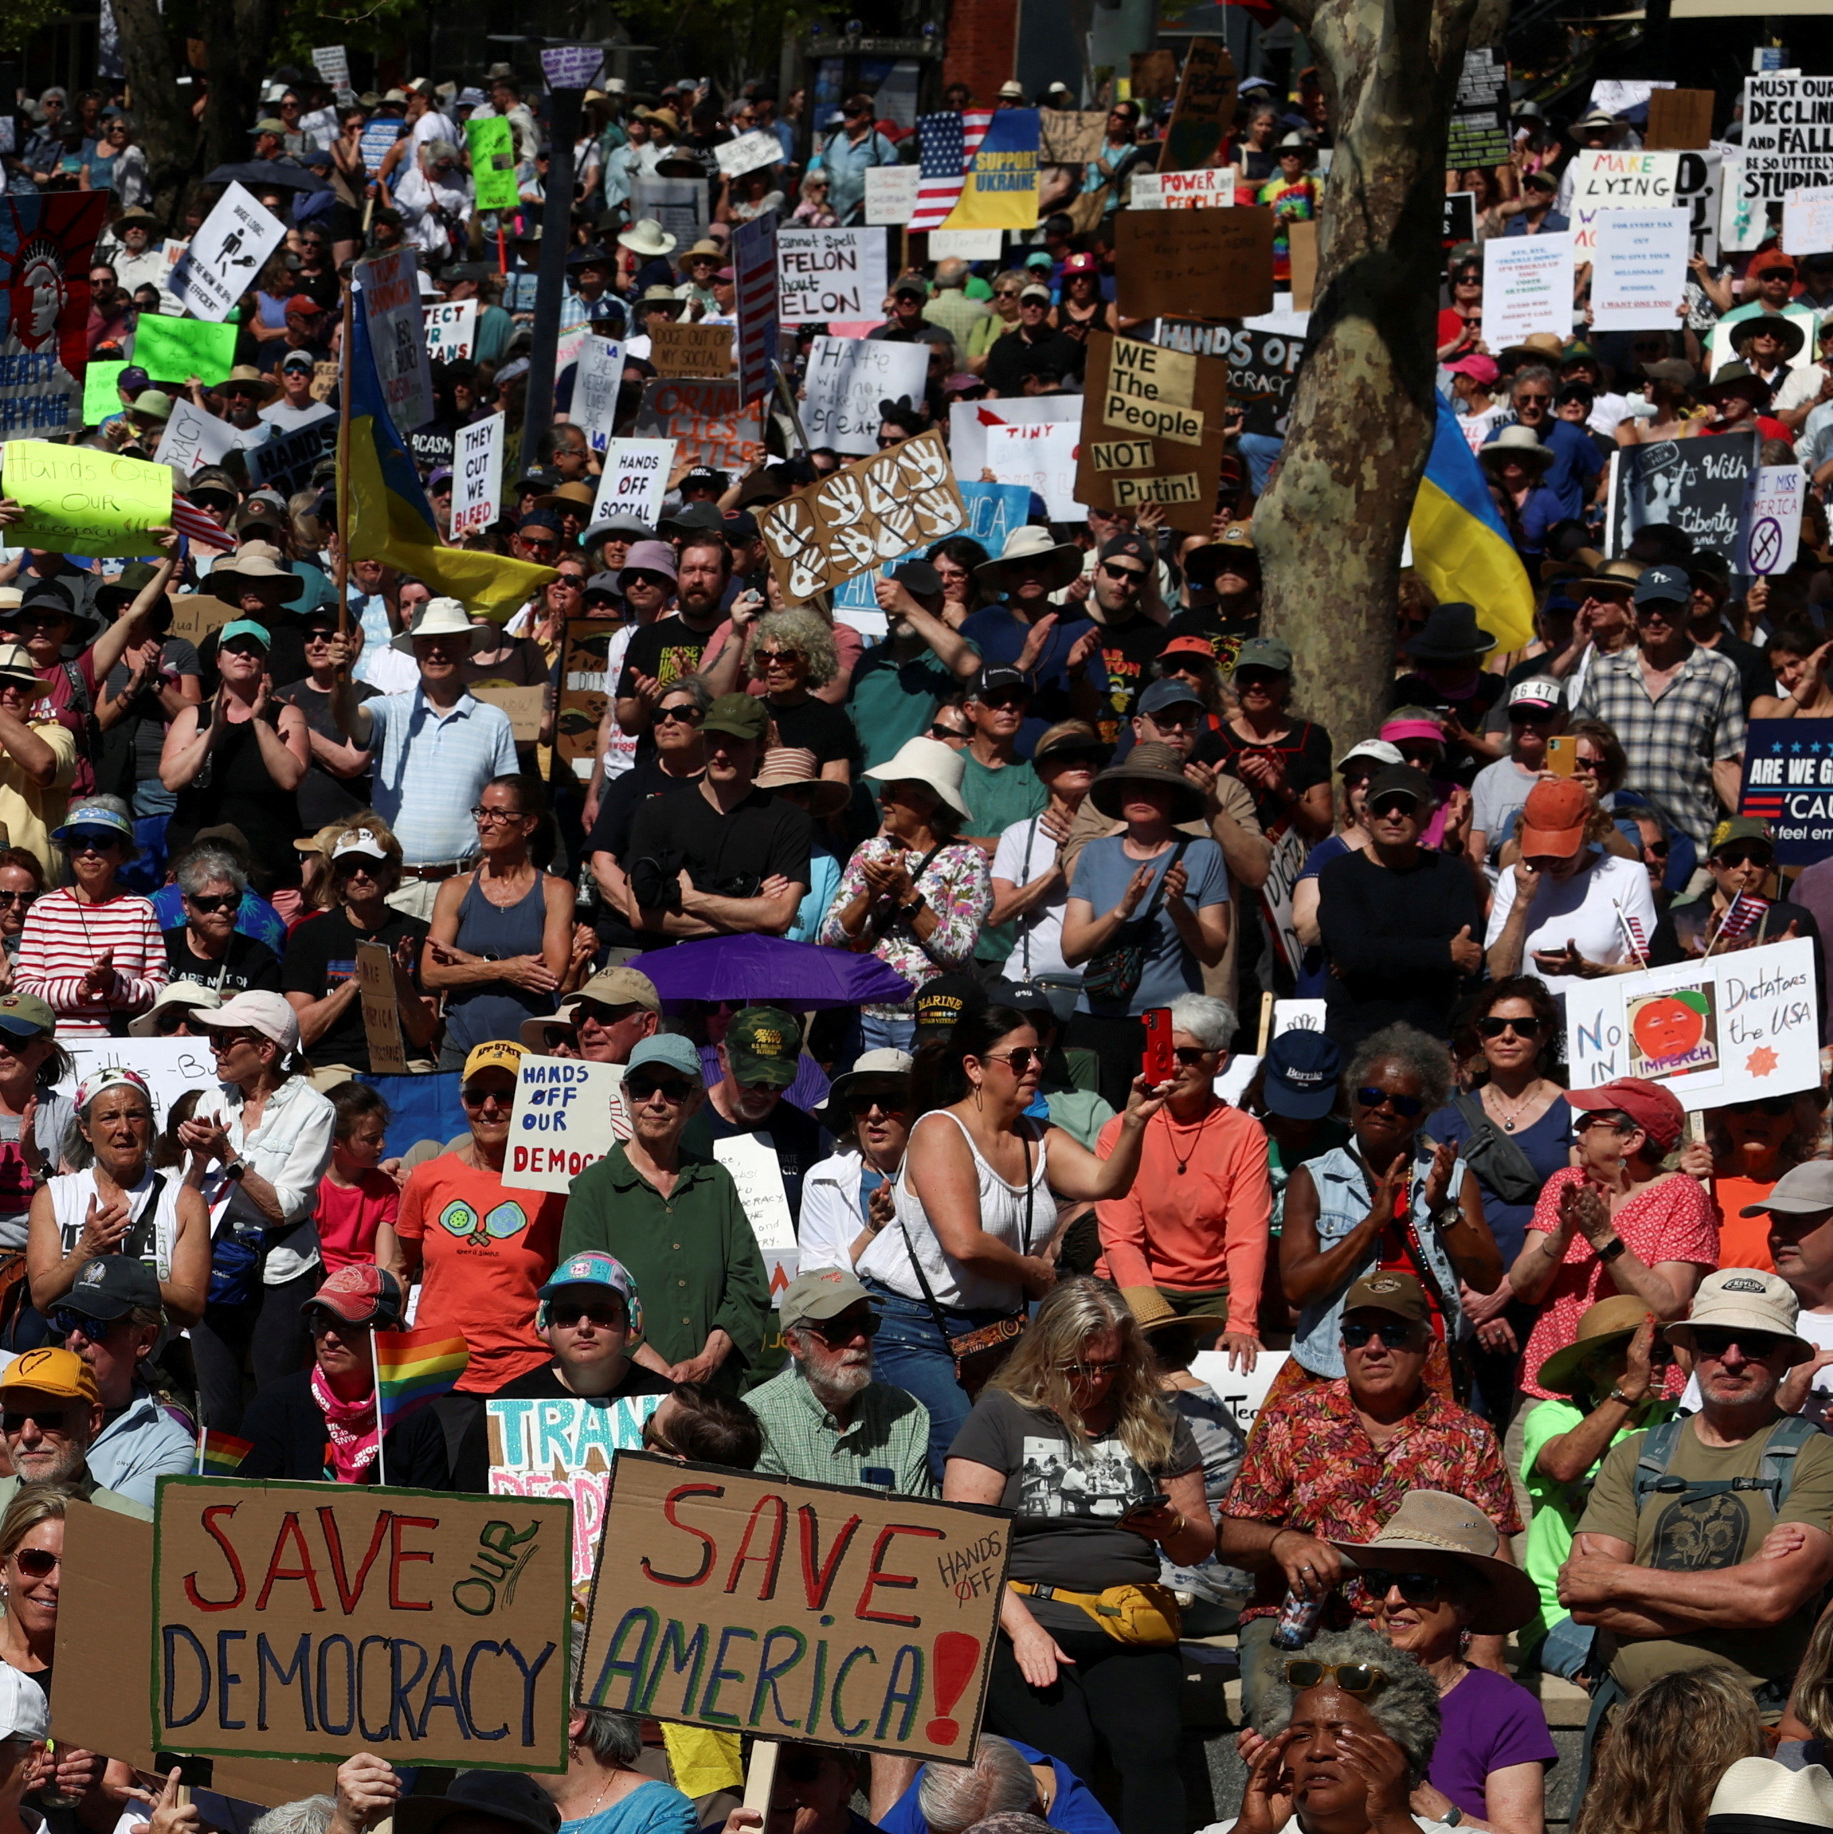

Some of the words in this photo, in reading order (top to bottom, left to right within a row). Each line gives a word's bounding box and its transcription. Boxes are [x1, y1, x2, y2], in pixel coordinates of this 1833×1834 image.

[1751, 81, 1797, 97] MUST
[1748, 136, 1776, 149] AND
[976, 152, 1037, 169] SUPPORT
[1593, 154, 1655, 173] MAKE
[975, 172, 1037, 191] UKRAINE
[1586, 178, 1669, 196] LYING
[782, 251, 856, 273] FELON
[782, 288, 861, 314] ELON
[1115, 346, 1157, 372] WE
[1112, 369, 1160, 400] The
[1106, 395, 1200, 438] People
[466, 425, 492, 451] THEY
[466, 453, 489, 477] CUT
[619, 456, 658, 469] HANDS
[1094, 445, 1150, 469] NOT
[468, 479, 484, 500] WE
[619, 477, 648, 494] OFF
[1117, 476, 1195, 505] Putin!
[1749, 758, 1784, 784] ARE
[1788, 758, 1817, 784] WE
[183, 1501, 439, 1615] SAVE
[454, 1520, 541, 1614] OUR
[642, 1484, 945, 1628] SAVE
[163, 1624, 557, 1748] DEMOCRACY
[593, 1605, 979, 1746] AMERICA!
